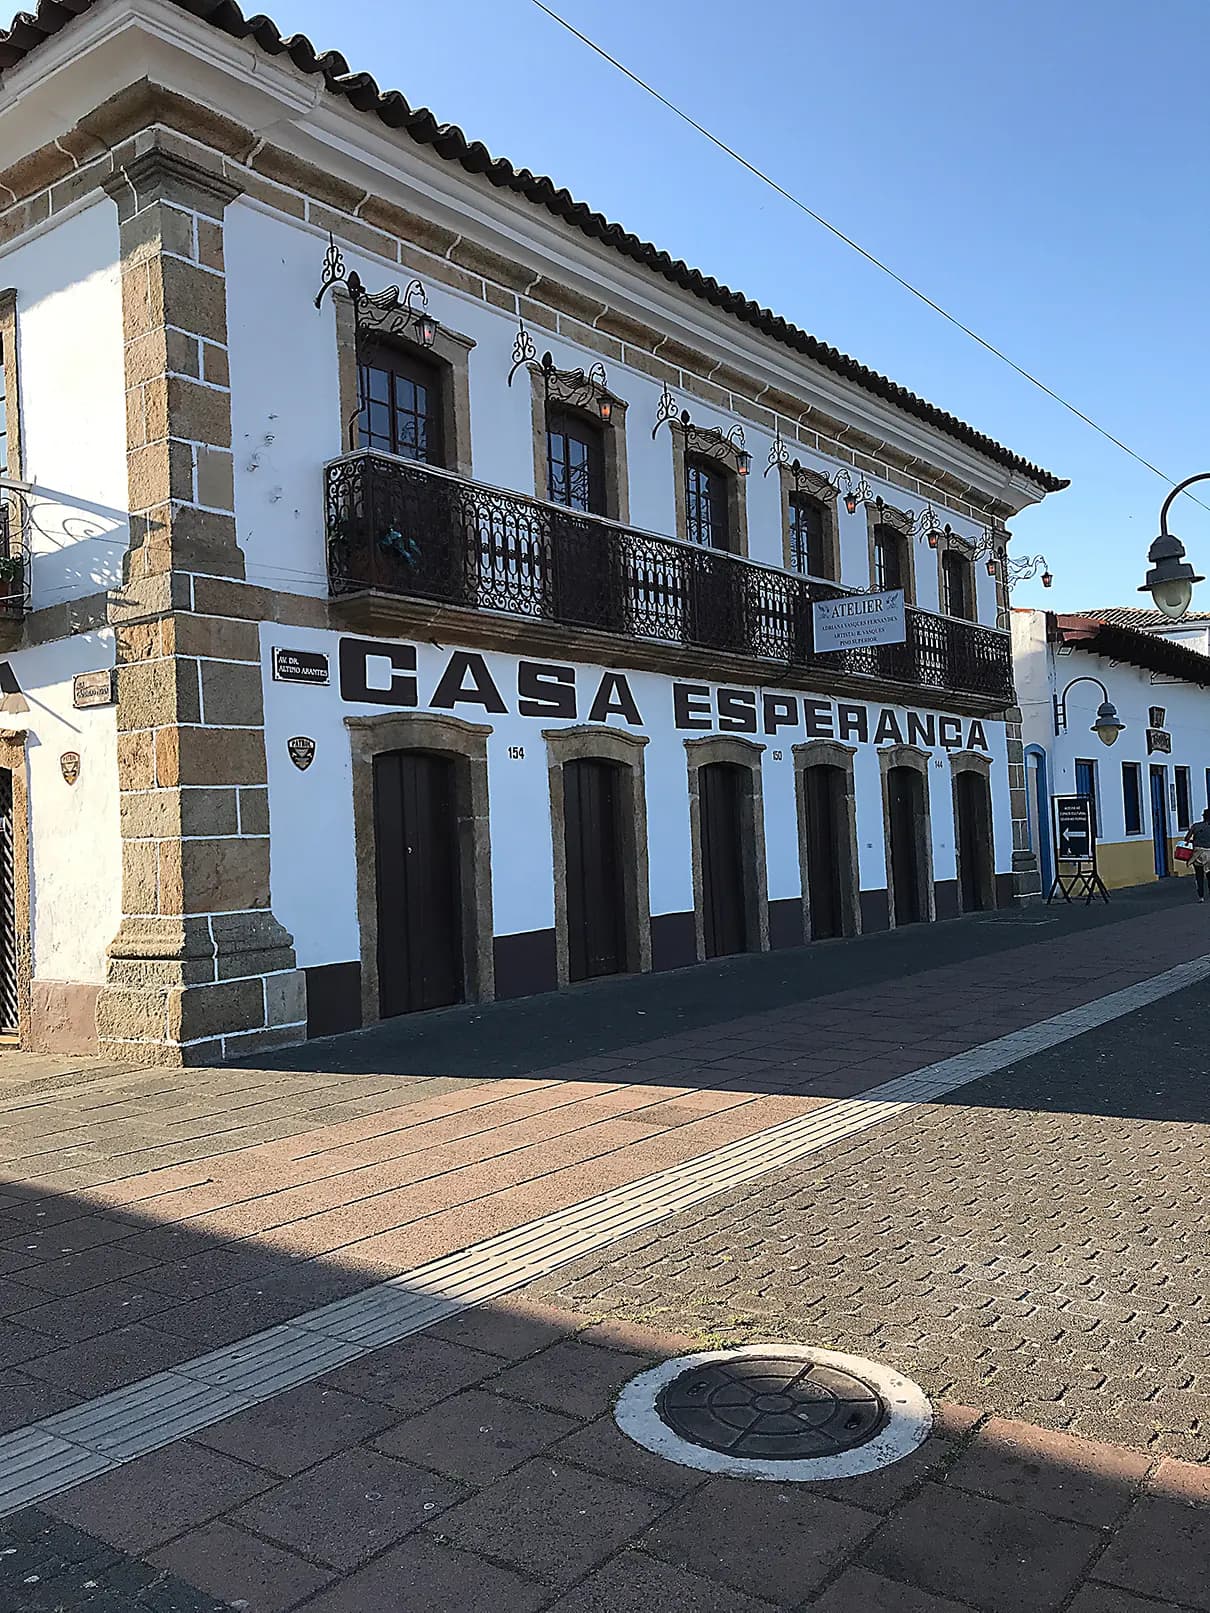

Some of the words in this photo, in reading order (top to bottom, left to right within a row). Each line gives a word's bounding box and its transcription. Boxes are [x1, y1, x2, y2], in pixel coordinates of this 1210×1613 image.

[831, 598, 883, 618] ATELIER
[279, 665, 301, 674] ALTINO
[301, 667, 328, 677] ARANTES
[338, 636, 644, 726] CASA
[672, 682, 989, 752] ESPERANÇA
[508, 746, 525, 759] 154
